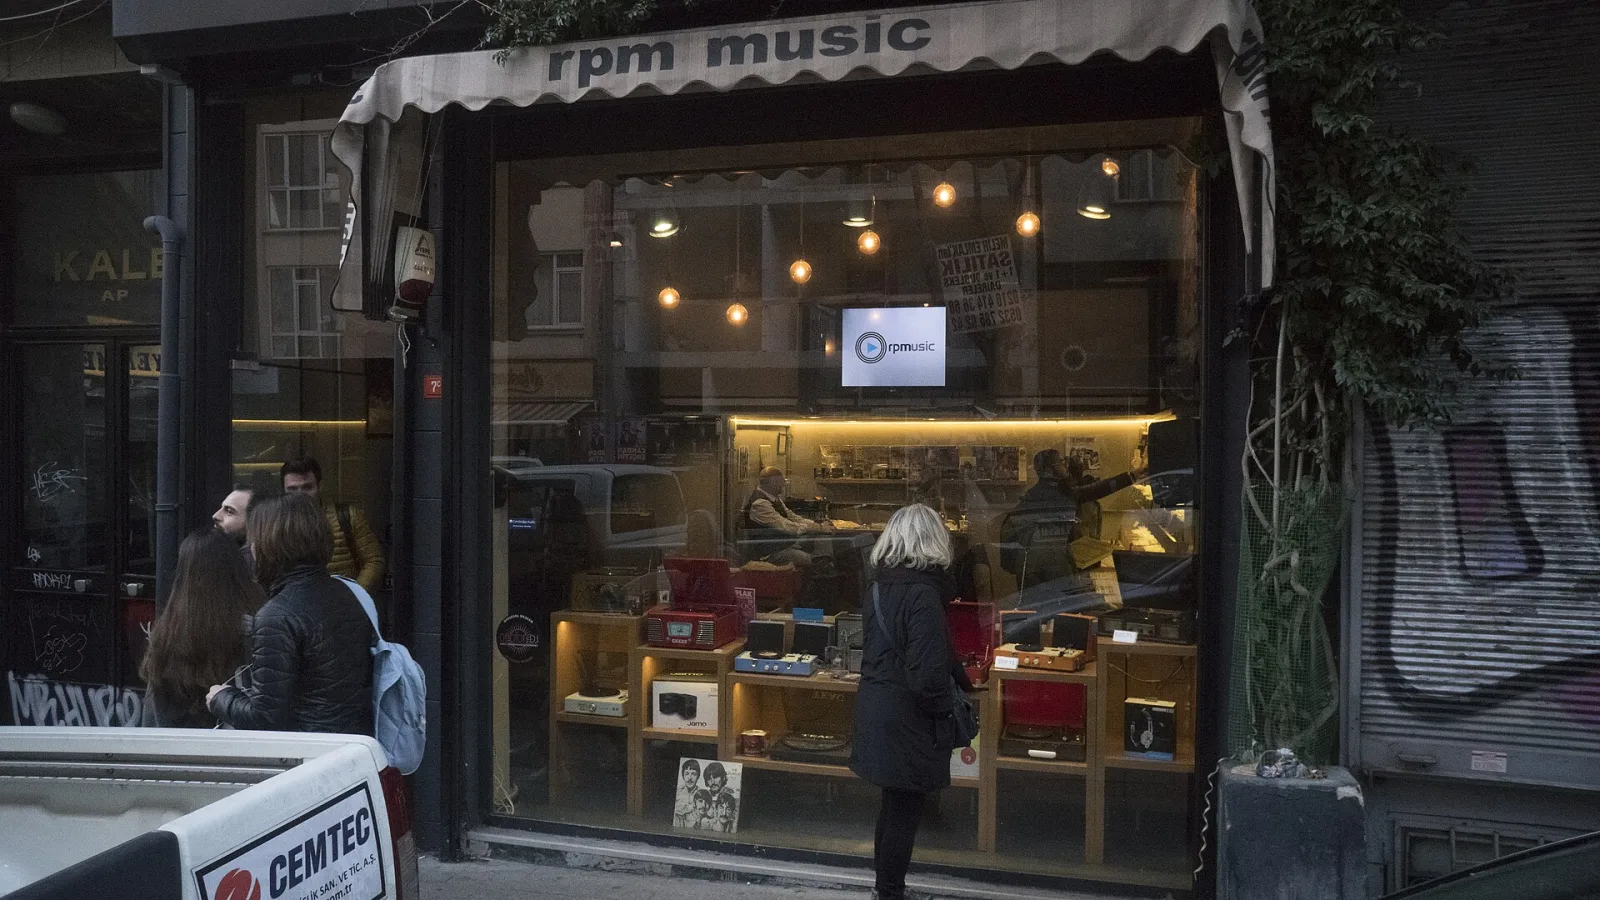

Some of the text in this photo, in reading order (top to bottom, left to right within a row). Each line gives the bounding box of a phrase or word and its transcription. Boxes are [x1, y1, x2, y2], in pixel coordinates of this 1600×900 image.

[548, 15, 931, 88] rpm music
[55, 248, 163, 282] KALE
[102, 289, 129, 302] AP
[888, 341, 935, 354] rpmusic
[269, 807, 371, 899] CEMTEC
[319, 879, 338, 896] SAN.
[338, 871, 348, 883] VE
